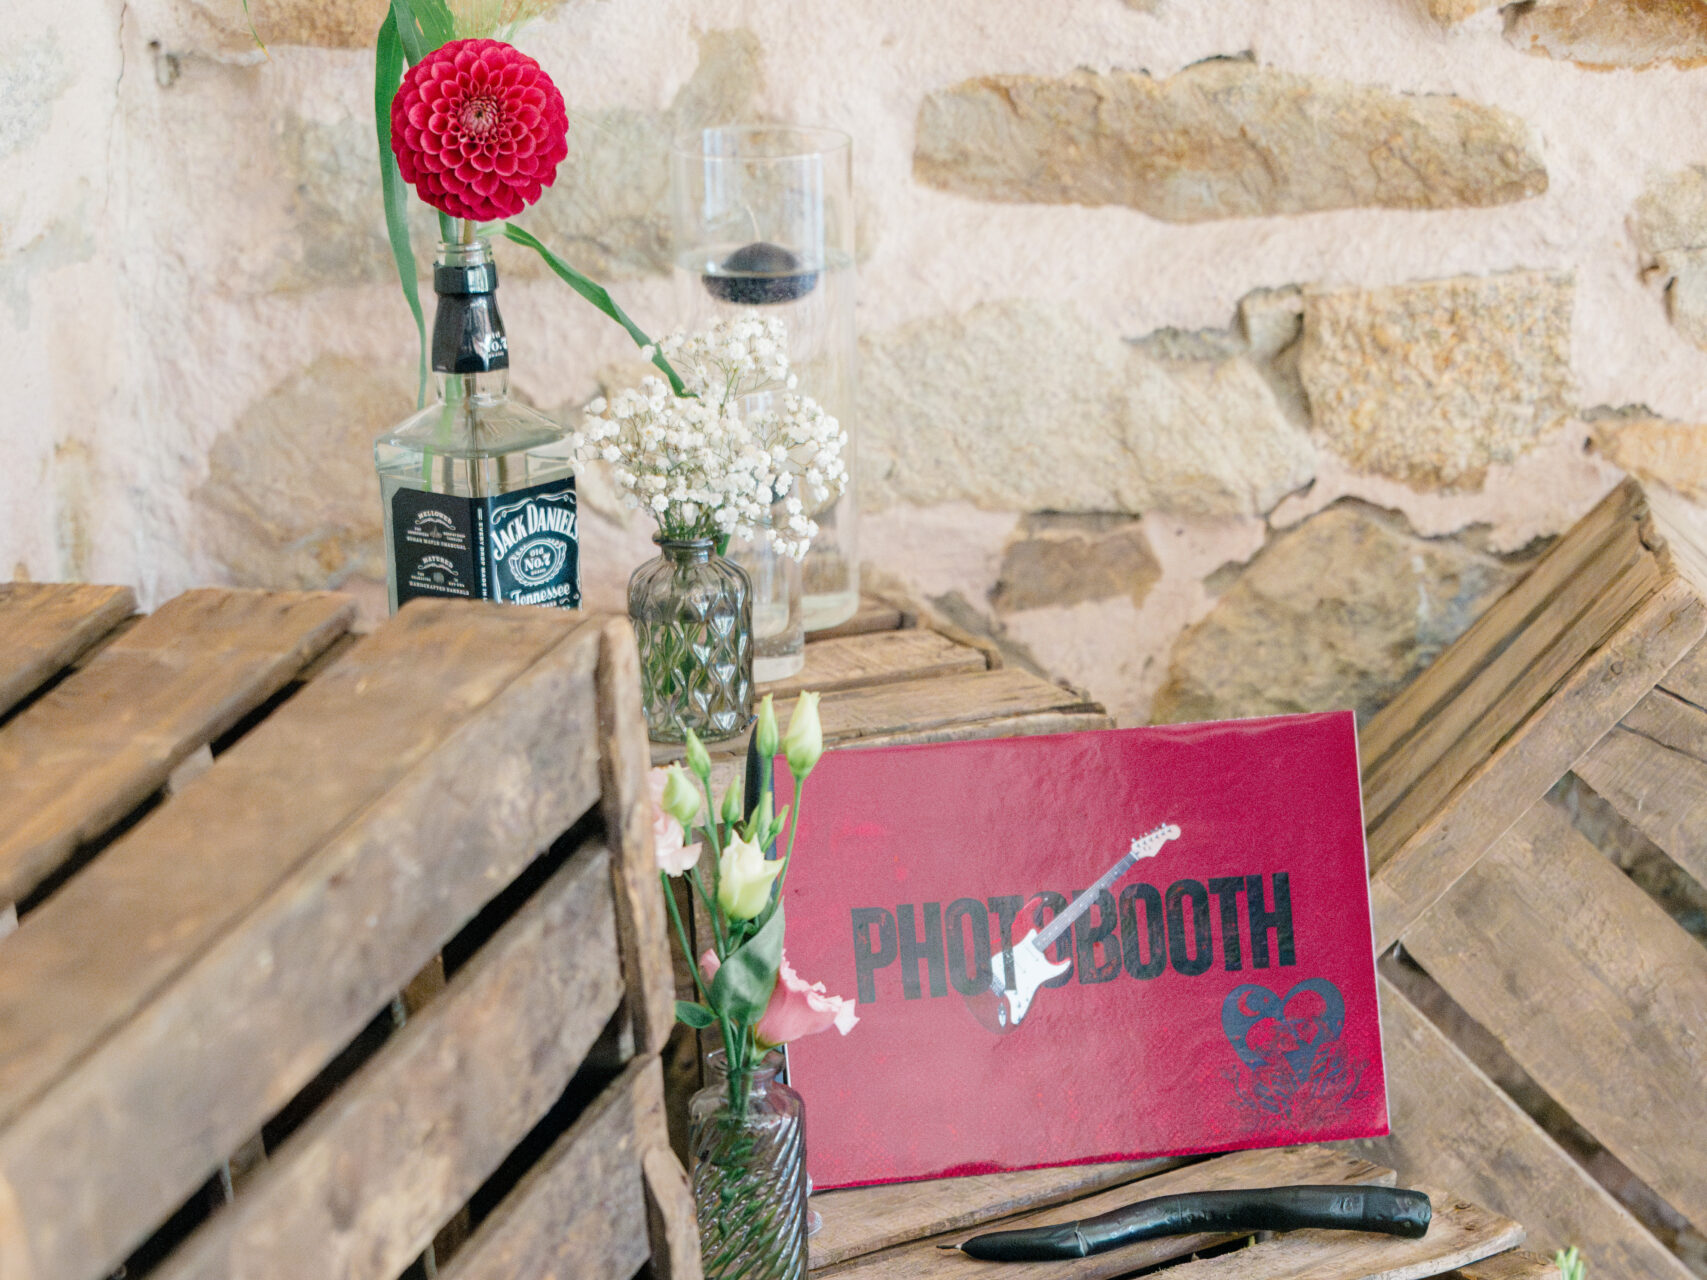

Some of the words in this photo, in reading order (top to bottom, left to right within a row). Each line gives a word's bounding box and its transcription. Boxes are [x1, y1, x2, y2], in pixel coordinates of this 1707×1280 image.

[490, 515, 528, 561] JACK
[510, 582, 571, 607] Tennessee
[850, 871, 1297, 1005] PHOTOBOOTH
